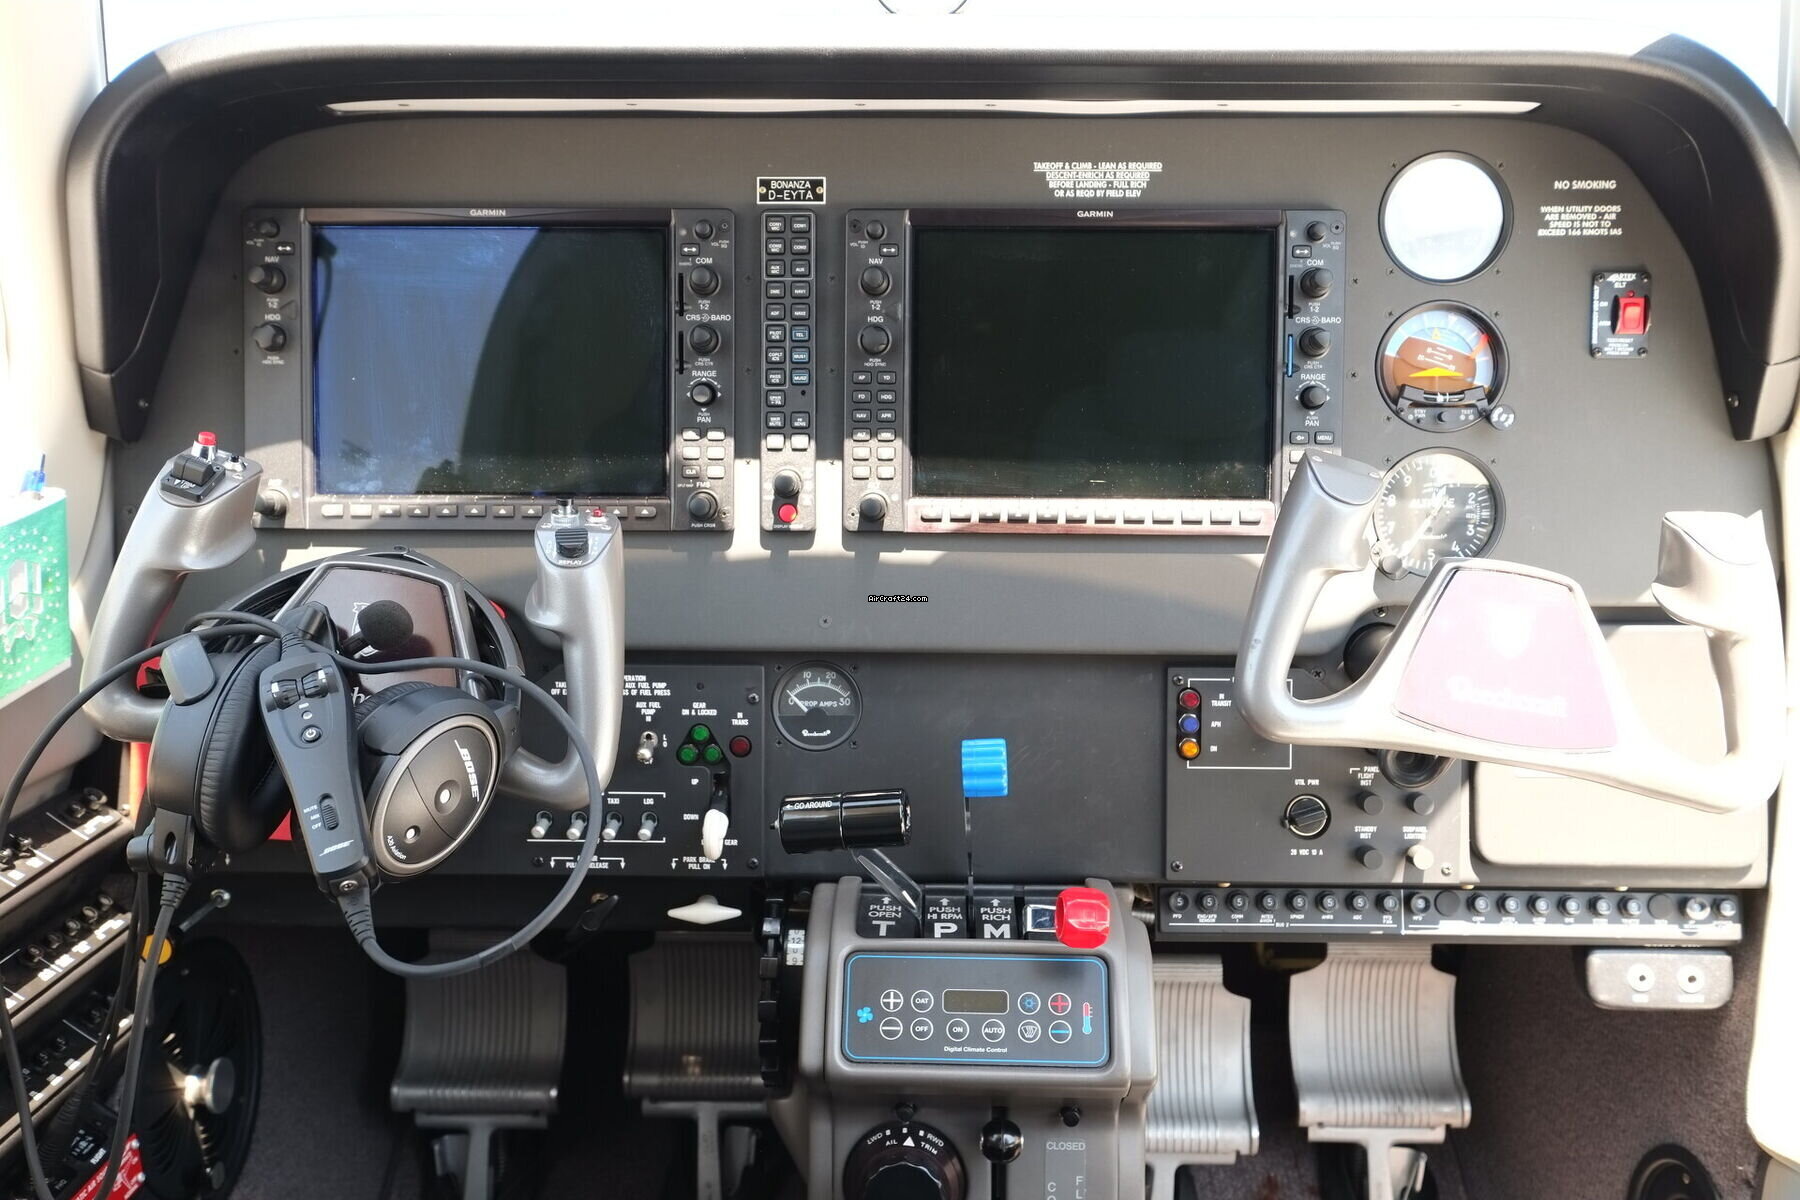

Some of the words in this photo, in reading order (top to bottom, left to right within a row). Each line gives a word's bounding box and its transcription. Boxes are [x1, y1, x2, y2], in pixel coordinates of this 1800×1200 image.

[1554, 180, 1570, 189] NO
[1572, 180, 1616, 190] SMOKING
[769, 190, 813, 200] D-EYTA
[1403, 477, 1412, 487] 9
[1468, 492, 1476, 504] 2
[1466, 524, 1474, 536] 3
[1452, 541, 1460, 552] 4
[1428, 549, 1435, 560] 5
[456, 741, 480, 802] BOSE
[804, 801, 832, 809] AROUND
[872, 920, 896, 936] T
[934, 923, 958, 938] P
[984, 924, 1011, 938] M
[867, 1132, 883, 1144] LWD
[926, 1133, 944, 1147] RWD
[920, 1141, 938, 1155] TRIM
[1046, 1141, 1086, 1150] CLOSED
